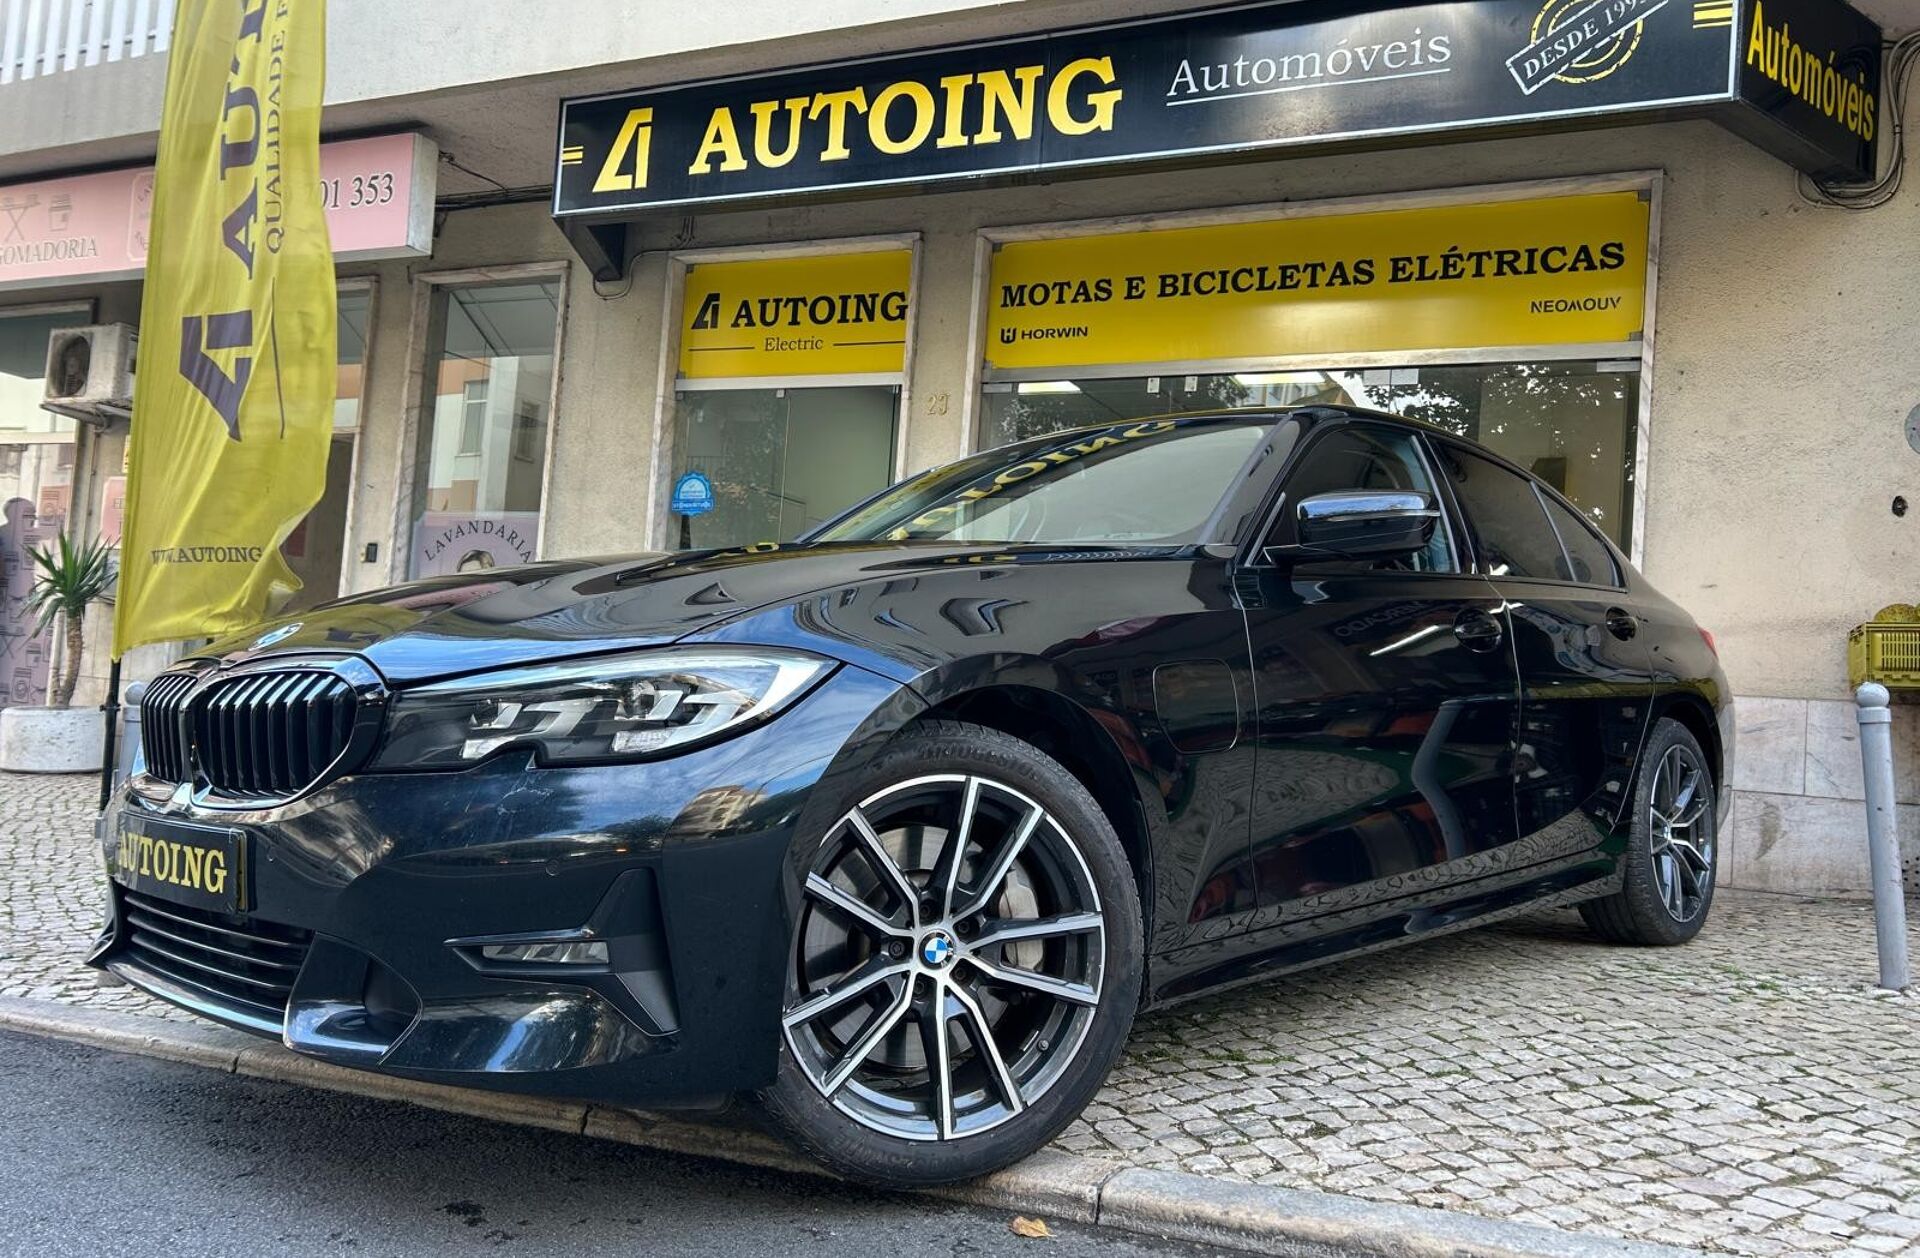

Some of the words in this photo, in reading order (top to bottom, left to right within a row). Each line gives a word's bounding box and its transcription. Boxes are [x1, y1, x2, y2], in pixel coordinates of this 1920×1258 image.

[1523, 17, 1599, 79] DESDE
[1604, 0, 1647, 26] 199
[1746, 0, 1875, 142] Automóveis
[688, 56, 1123, 176] AUTOING
[1166, 27, 1452, 97] Automóveis
[265, 30, 286, 254] QUALIDADE
[350, 173, 394, 206] 353
[1000, 277, 1113, 308] MOTAS
[1123, 276, 1146, 300] E
[1156, 258, 1376, 298] BICICLETAS
[1387, 242, 1625, 283] ELÉTRICAS
[730, 290, 909, 328] AUTOING
[1021, 325, 1088, 340] HORWIN
[763, 335, 824, 352] Electric
[424, 520, 533, 564] LAVANDARIA
[118, 829, 228, 894] AUTOING
